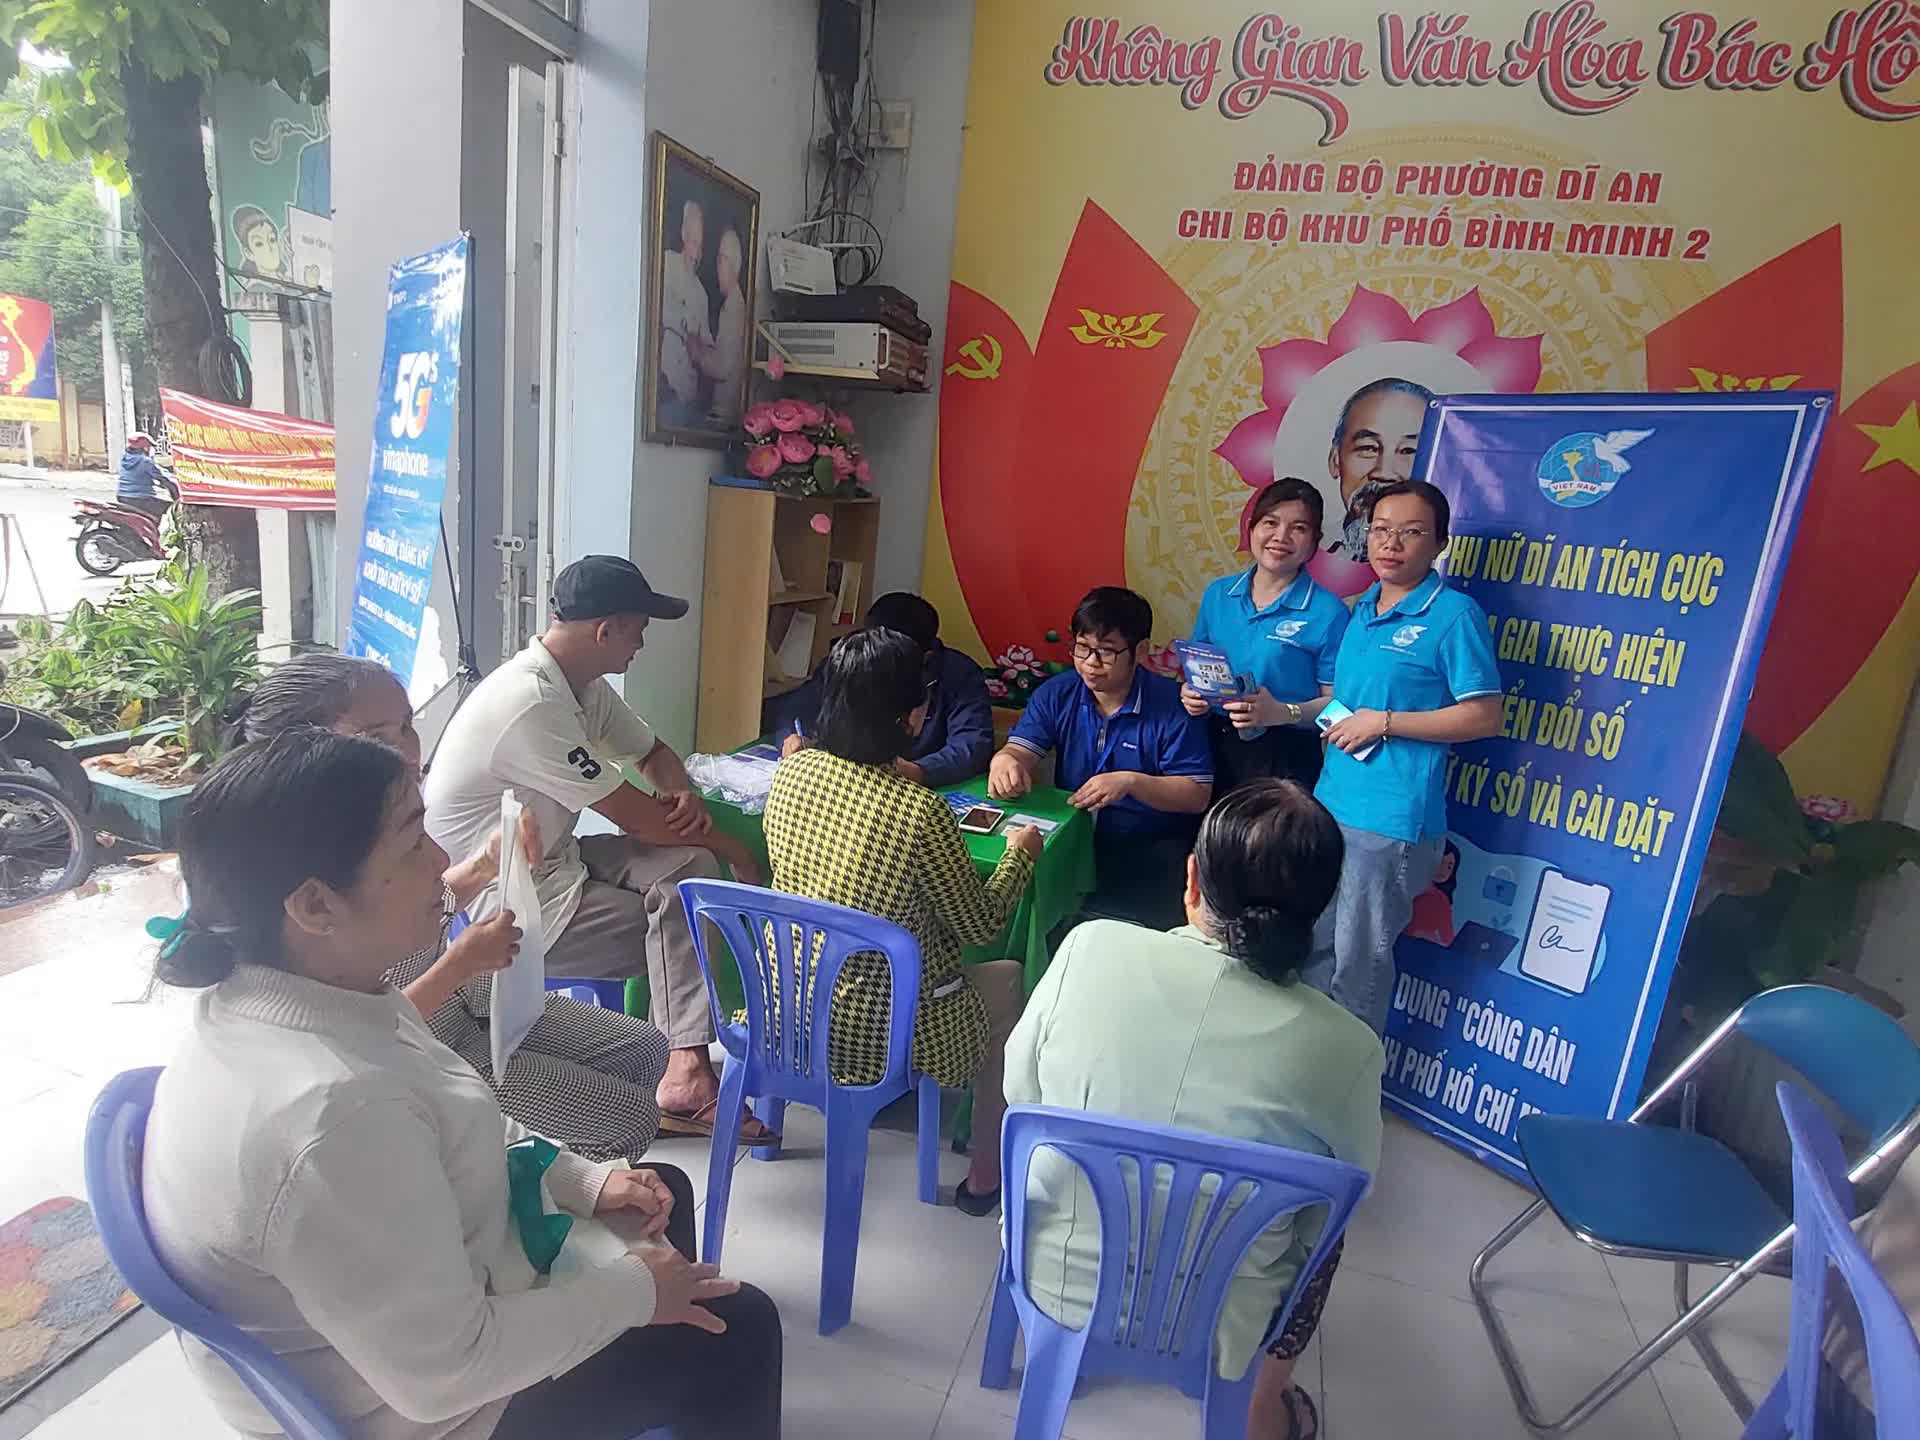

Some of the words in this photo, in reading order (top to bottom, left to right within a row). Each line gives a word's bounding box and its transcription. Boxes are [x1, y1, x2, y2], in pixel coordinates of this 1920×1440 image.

[1044, 15, 1221, 109] Không
[1218, 12, 1368, 146] Gian
[1378, 12, 1498, 87] Văn
[1498, 0, 1649, 116] Hóa
[1657, 11, 1793, 91] Bác
[1233, 153, 1325, 194] ĐẢNG
[1337, 159, 1383, 200] BỘ
[1395, 160, 1543, 199] PHƯỜNG
[1556, 164, 1601, 201] DĨ
[1608, 171, 1663, 204] AN
[1178, 209, 1231, 240] CHI
[1244, 210, 1288, 247] BỘ
[1300, 213, 1370, 245] KHU
[1382, 206, 1451, 248] PHỐ
[1464, 214, 1554, 252] BÌNH
[1566, 222, 1674, 258] MINH
[1683, 228, 1711, 260] 2
[1482, 531, 1526, 583] NỮ
[1521, 534, 1556, 586] DĨ
[1550, 545, 1594, 591] AN
[1596, 539, 1659, 598] TÍCH
[1661, 551, 1724, 614] CỰC
[1500, 617, 1541, 665] GIA
[1545, 624, 1613, 682] THỰC
[1613, 627, 1686, 694] HIỆN
[567, 746, 602, 780] 3
[1535, 689, 1583, 752] ĐỔI
[1584, 700, 1632, 760] SỐ
[1456, 757, 1490, 807] KÝ
[1490, 761, 1532, 817] SỐ
[1529, 775, 1563, 829] VÀ
[1565, 784, 1615, 842] CÀI
[1614, 796, 1675, 863] ĐẶT
[1393, 972, 1450, 1029] DỤNG
[1522, 1026, 1576, 1087] DÂN
[1400, 1047, 1448, 1098] PHỐ
[1441, 1063, 1477, 1115] HỒ
[1474, 1083, 1518, 1136] CHÍ
